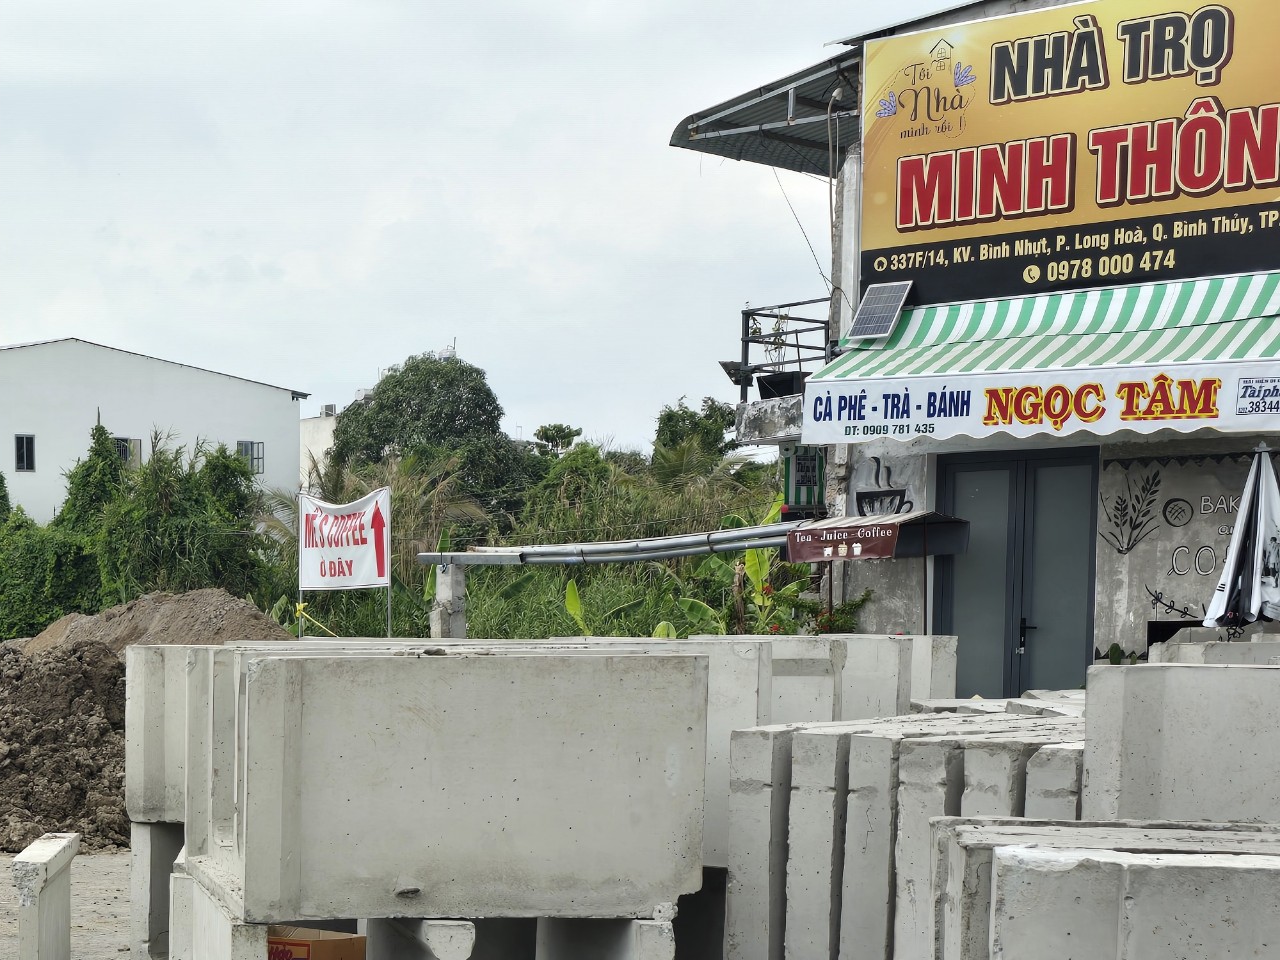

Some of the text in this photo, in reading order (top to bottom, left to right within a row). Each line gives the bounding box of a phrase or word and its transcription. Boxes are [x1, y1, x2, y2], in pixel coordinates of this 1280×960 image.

[989, 4, 1234, 105] NHÀ TRỌ
[898, 86, 969, 121] Nhà
[896, 133, 1077, 233] MINH
[890, 251, 949, 271] 337F/14,
[953, 246, 975, 264] KV.
[980, 240, 1009, 261] Bình
[1015, 237, 1051, 258] Nhựt,
[1056, 235, 1070, 252] P.
[1075, 232, 1109, 250] Long
[1114, 225, 1147, 246] Hoà,
[1153, 223, 1168, 242] Q.
[1173, 220, 1207, 239] Bình
[1211, 212, 1253, 235] Thủy,
[1047, 249, 1176, 283] 0978 000 474
[813, 390, 832, 422] CÀ
[837, 389, 867, 421] PHÊ
[882, 387, 911, 420] TRÀ
[926, 386, 971, 418] BÁNH
[982, 372, 1222, 431] NGỌC TÂM
[1240, 385, 1280, 401] Tàiph
[862, 424, 889, 436] 0909
[892, 424, 911, 435] 781
[914, 423, 935, 435] 435
[795, 532, 812, 543] Tea
[820, 531, 848, 541] Juice
[857, 527, 893, 538] Coffee
[329, 557, 353, 578] ĐÂY
